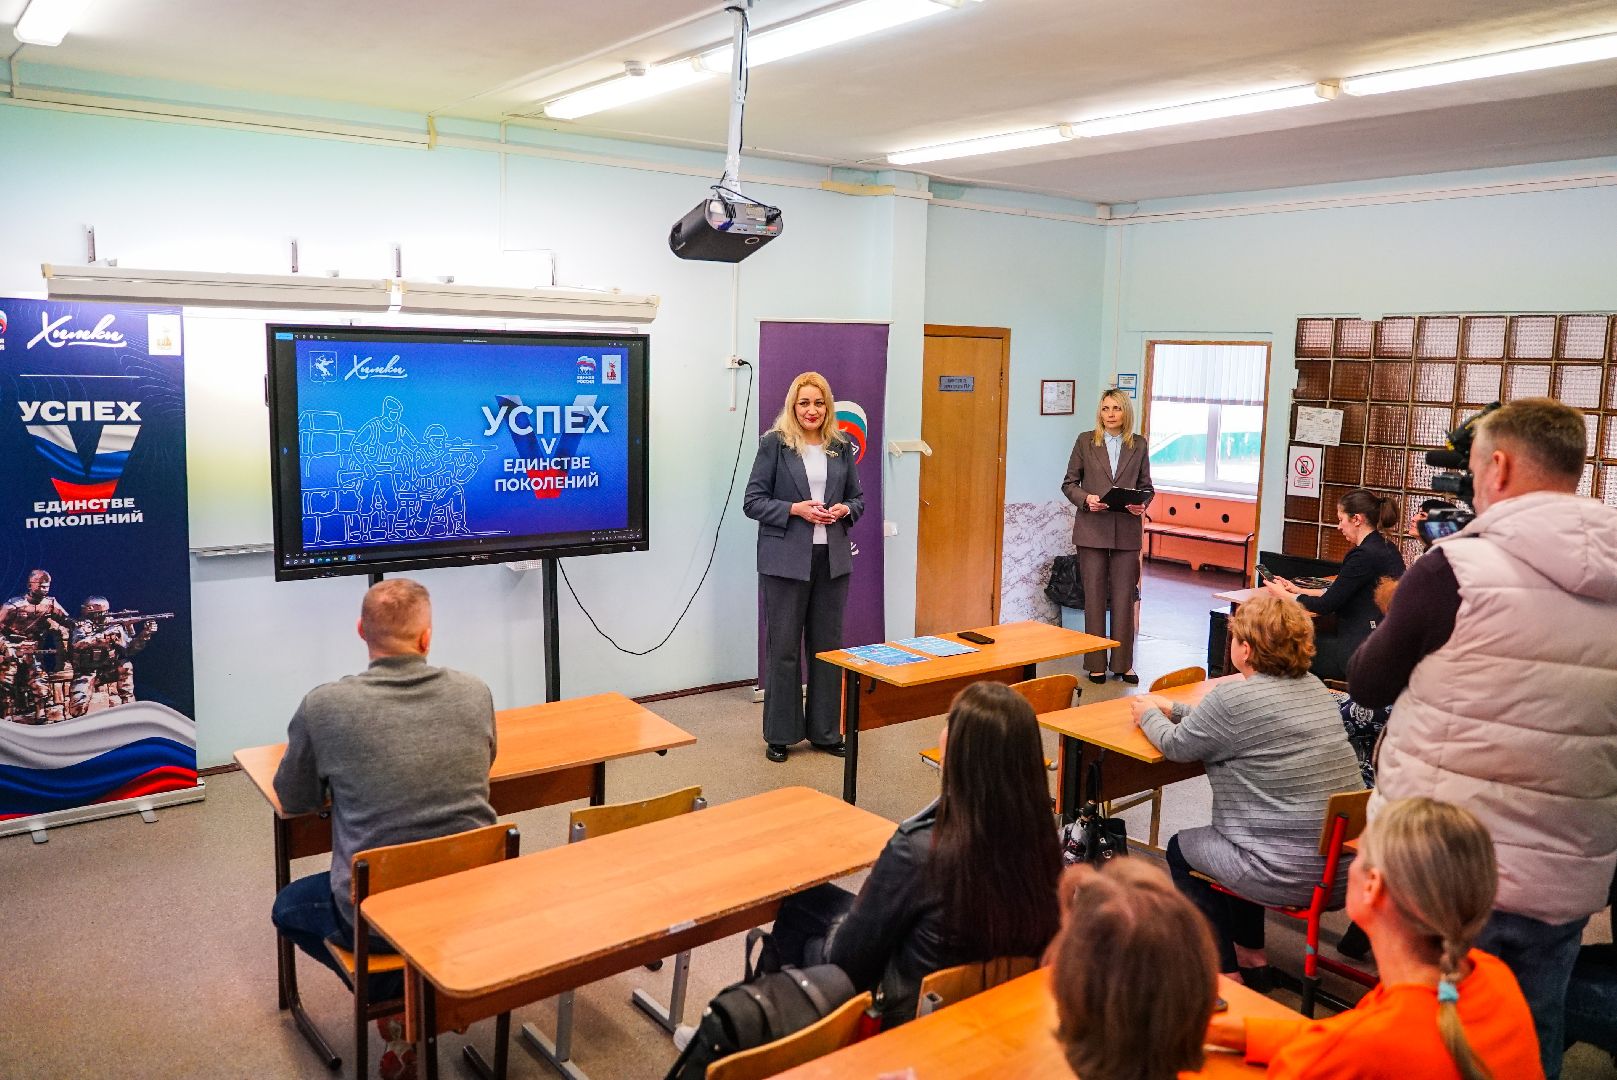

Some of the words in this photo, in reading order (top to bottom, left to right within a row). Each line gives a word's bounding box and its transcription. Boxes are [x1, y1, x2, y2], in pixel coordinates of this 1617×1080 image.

[27, 311, 128, 350] Химки
[344, 354, 408, 381] Химки
[18, 401, 142, 422] УСПЕХ
[481, 404, 610, 437] УСПЕХ
[541, 437, 557, 455] V
[503, 456, 591, 474] ЕДИНСТВЕ
[494, 473, 600, 492] ПОКОЛЕНИЙ
[33, 497, 135, 514] ЕДИНСТВЕ
[25, 510, 144, 529] ПОКОЛЕНИЙ
